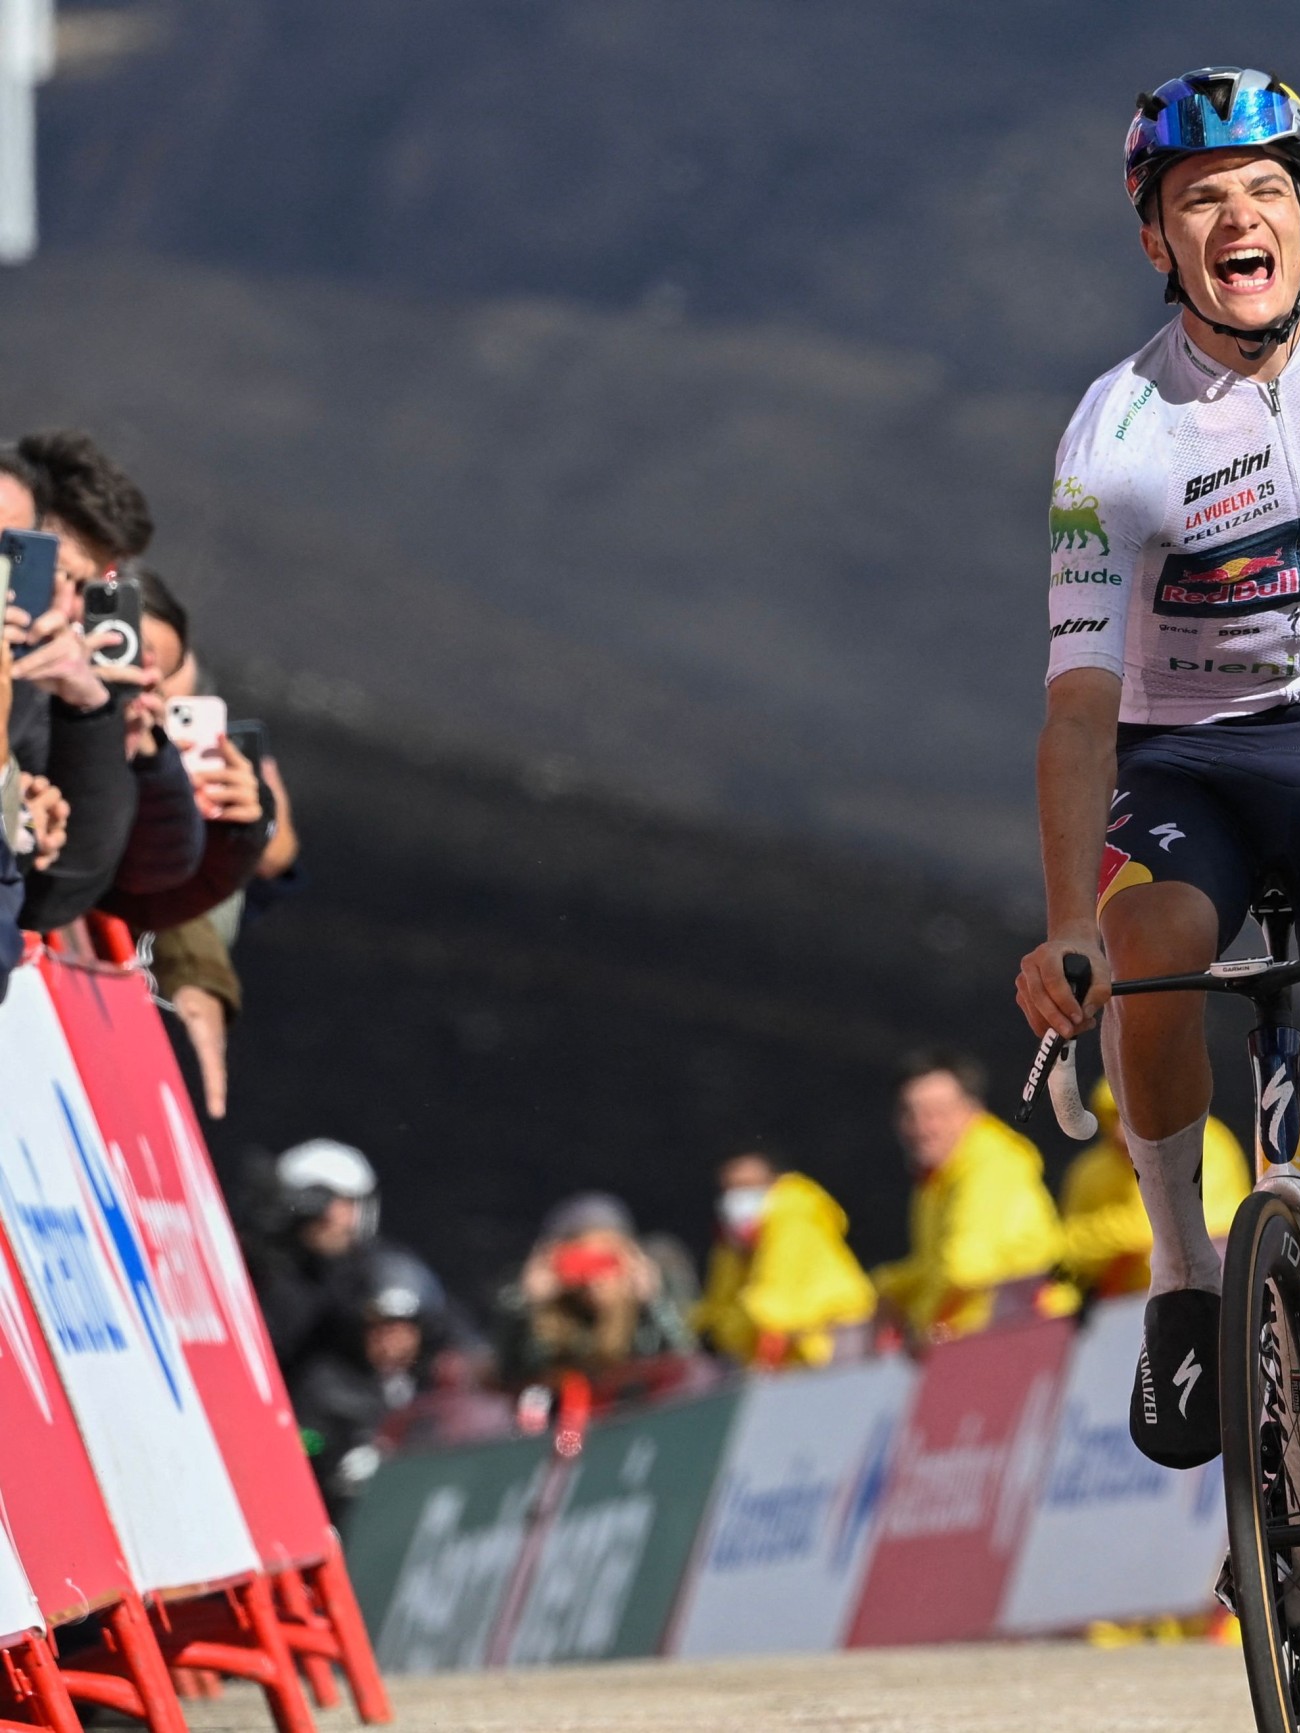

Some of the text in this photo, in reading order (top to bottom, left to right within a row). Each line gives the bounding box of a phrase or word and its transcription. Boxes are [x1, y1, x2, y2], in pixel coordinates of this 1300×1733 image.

[1115, 380, 1158, 440] plenitude
[1183, 444, 1271, 505] Santini
[1184, 499, 1279, 544] PELLIZZARI
[1185, 479, 1275, 530] LA VUELTA 25
[1050, 566, 1123, 588] nitude
[1162, 567, 1299, 604] Red Bull
[1050, 617, 1110, 642] ntini
[1159, 624, 1199, 635] grenke
[1218, 627, 1261, 637] BOSS
[1022, 1027, 1059, 1102] SRAM
